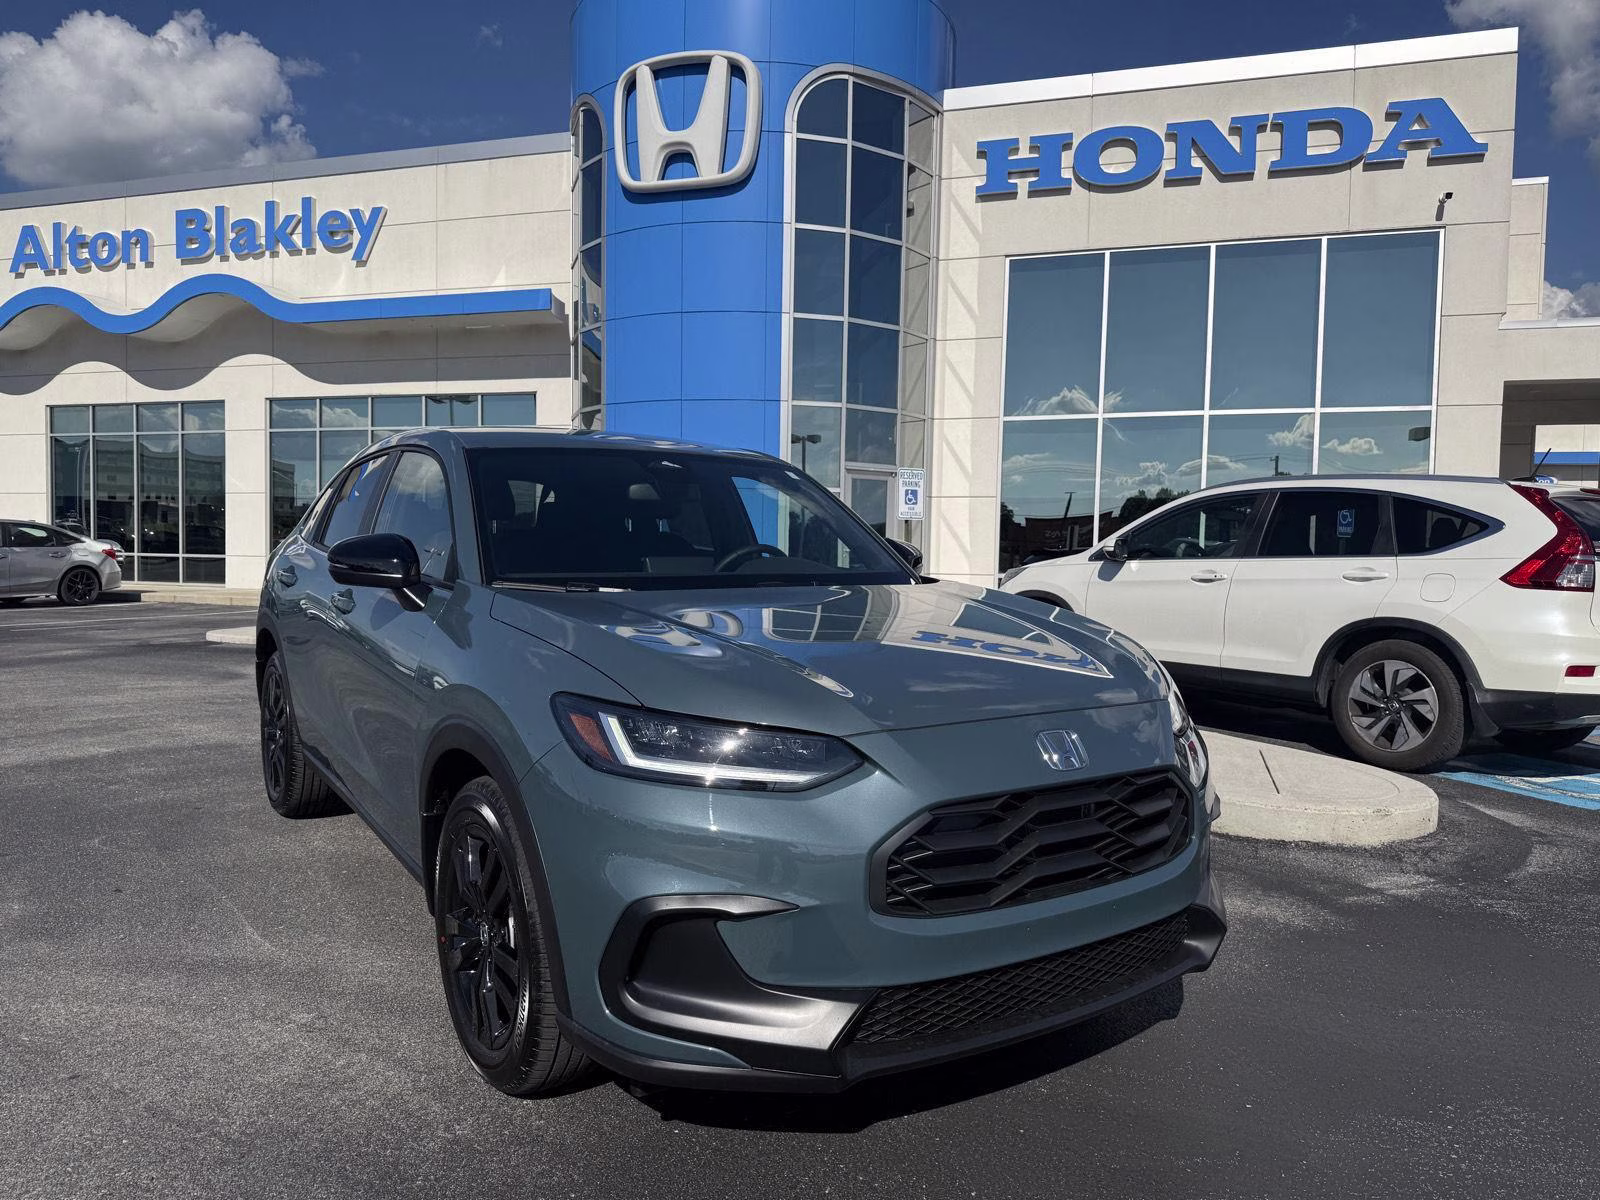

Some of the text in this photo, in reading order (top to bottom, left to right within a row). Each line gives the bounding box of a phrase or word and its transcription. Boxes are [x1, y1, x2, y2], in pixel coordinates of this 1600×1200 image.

[975, 97, 1488, 199] HONDA
[9, 196, 388, 276] Alton Blakley
[900, 471, 923, 480] RESERVED
[902, 480, 920, 488] PARKING
